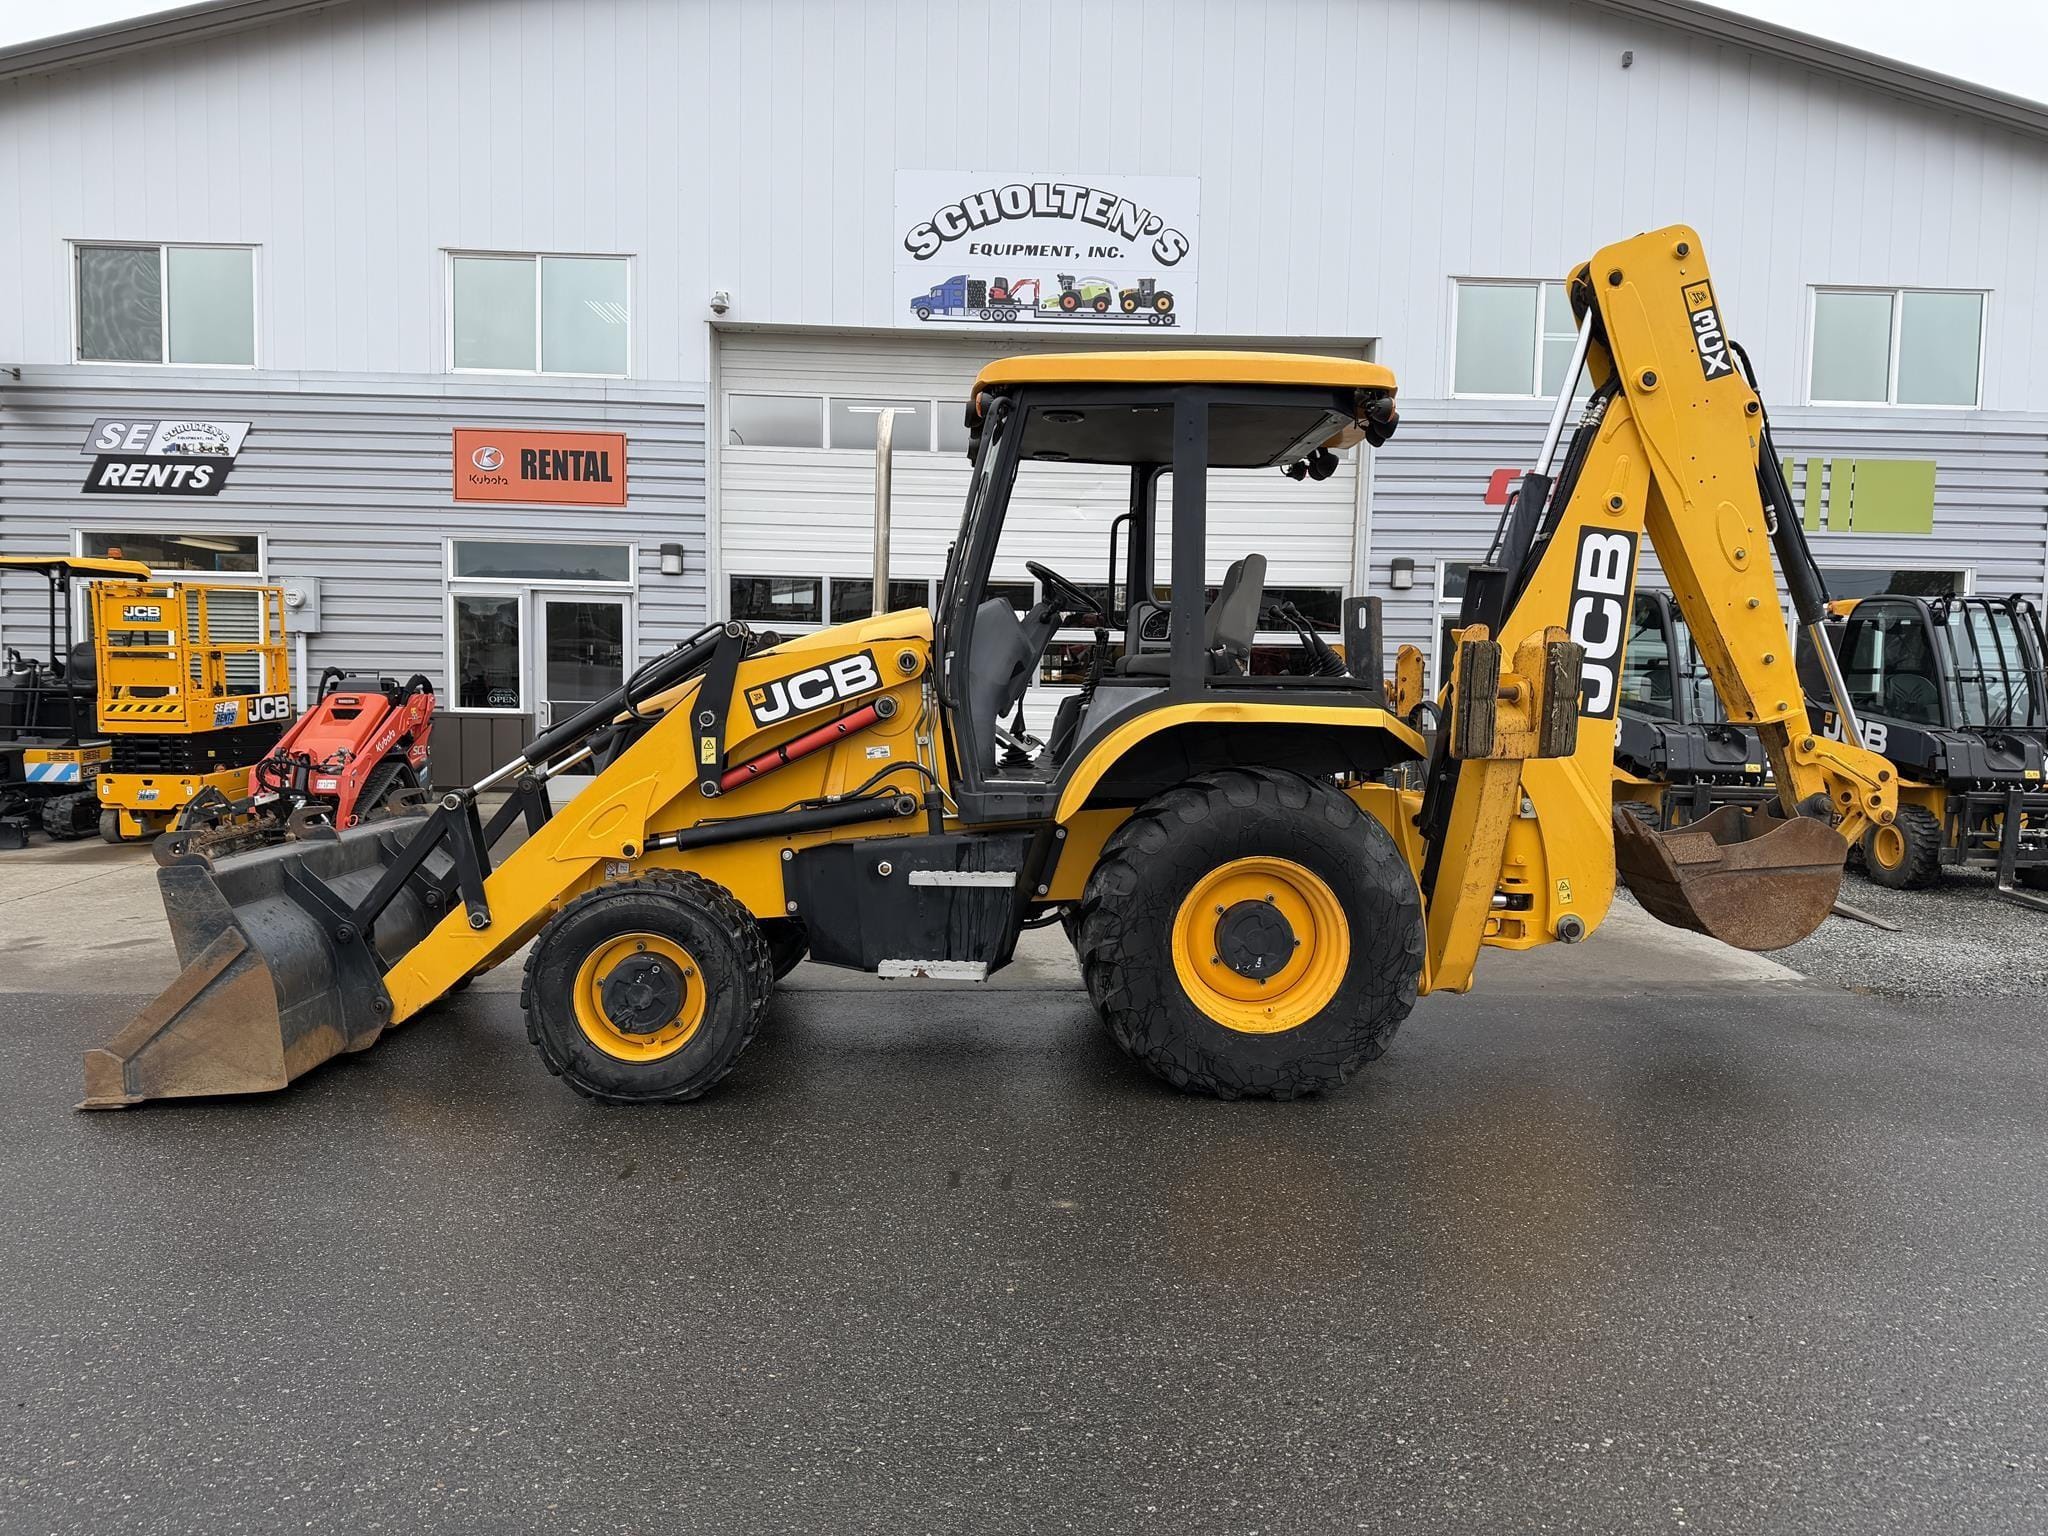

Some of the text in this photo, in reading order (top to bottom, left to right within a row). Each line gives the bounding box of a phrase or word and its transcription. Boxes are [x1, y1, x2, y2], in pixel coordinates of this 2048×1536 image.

[904, 183, 1189, 266] SCHOLTEN'S
[969, 243, 1125, 260] EQUIPMENT, INC.
[1693, 309, 1731, 376] 3CX
[95, 422, 155, 450] SE
[98, 463, 214, 488] RENTS
[520, 448, 613, 483] RENTAL
[469, 474, 508, 485] Kubota
[124, 606, 160, 616] JCB
[1571, 533, 1631, 713] JCB
[489, 696, 516, 704] OPEN
[755, 655, 878, 722] JCB
[249, 697, 289, 722] JCB
[375, 729, 396, 752] Kubota
